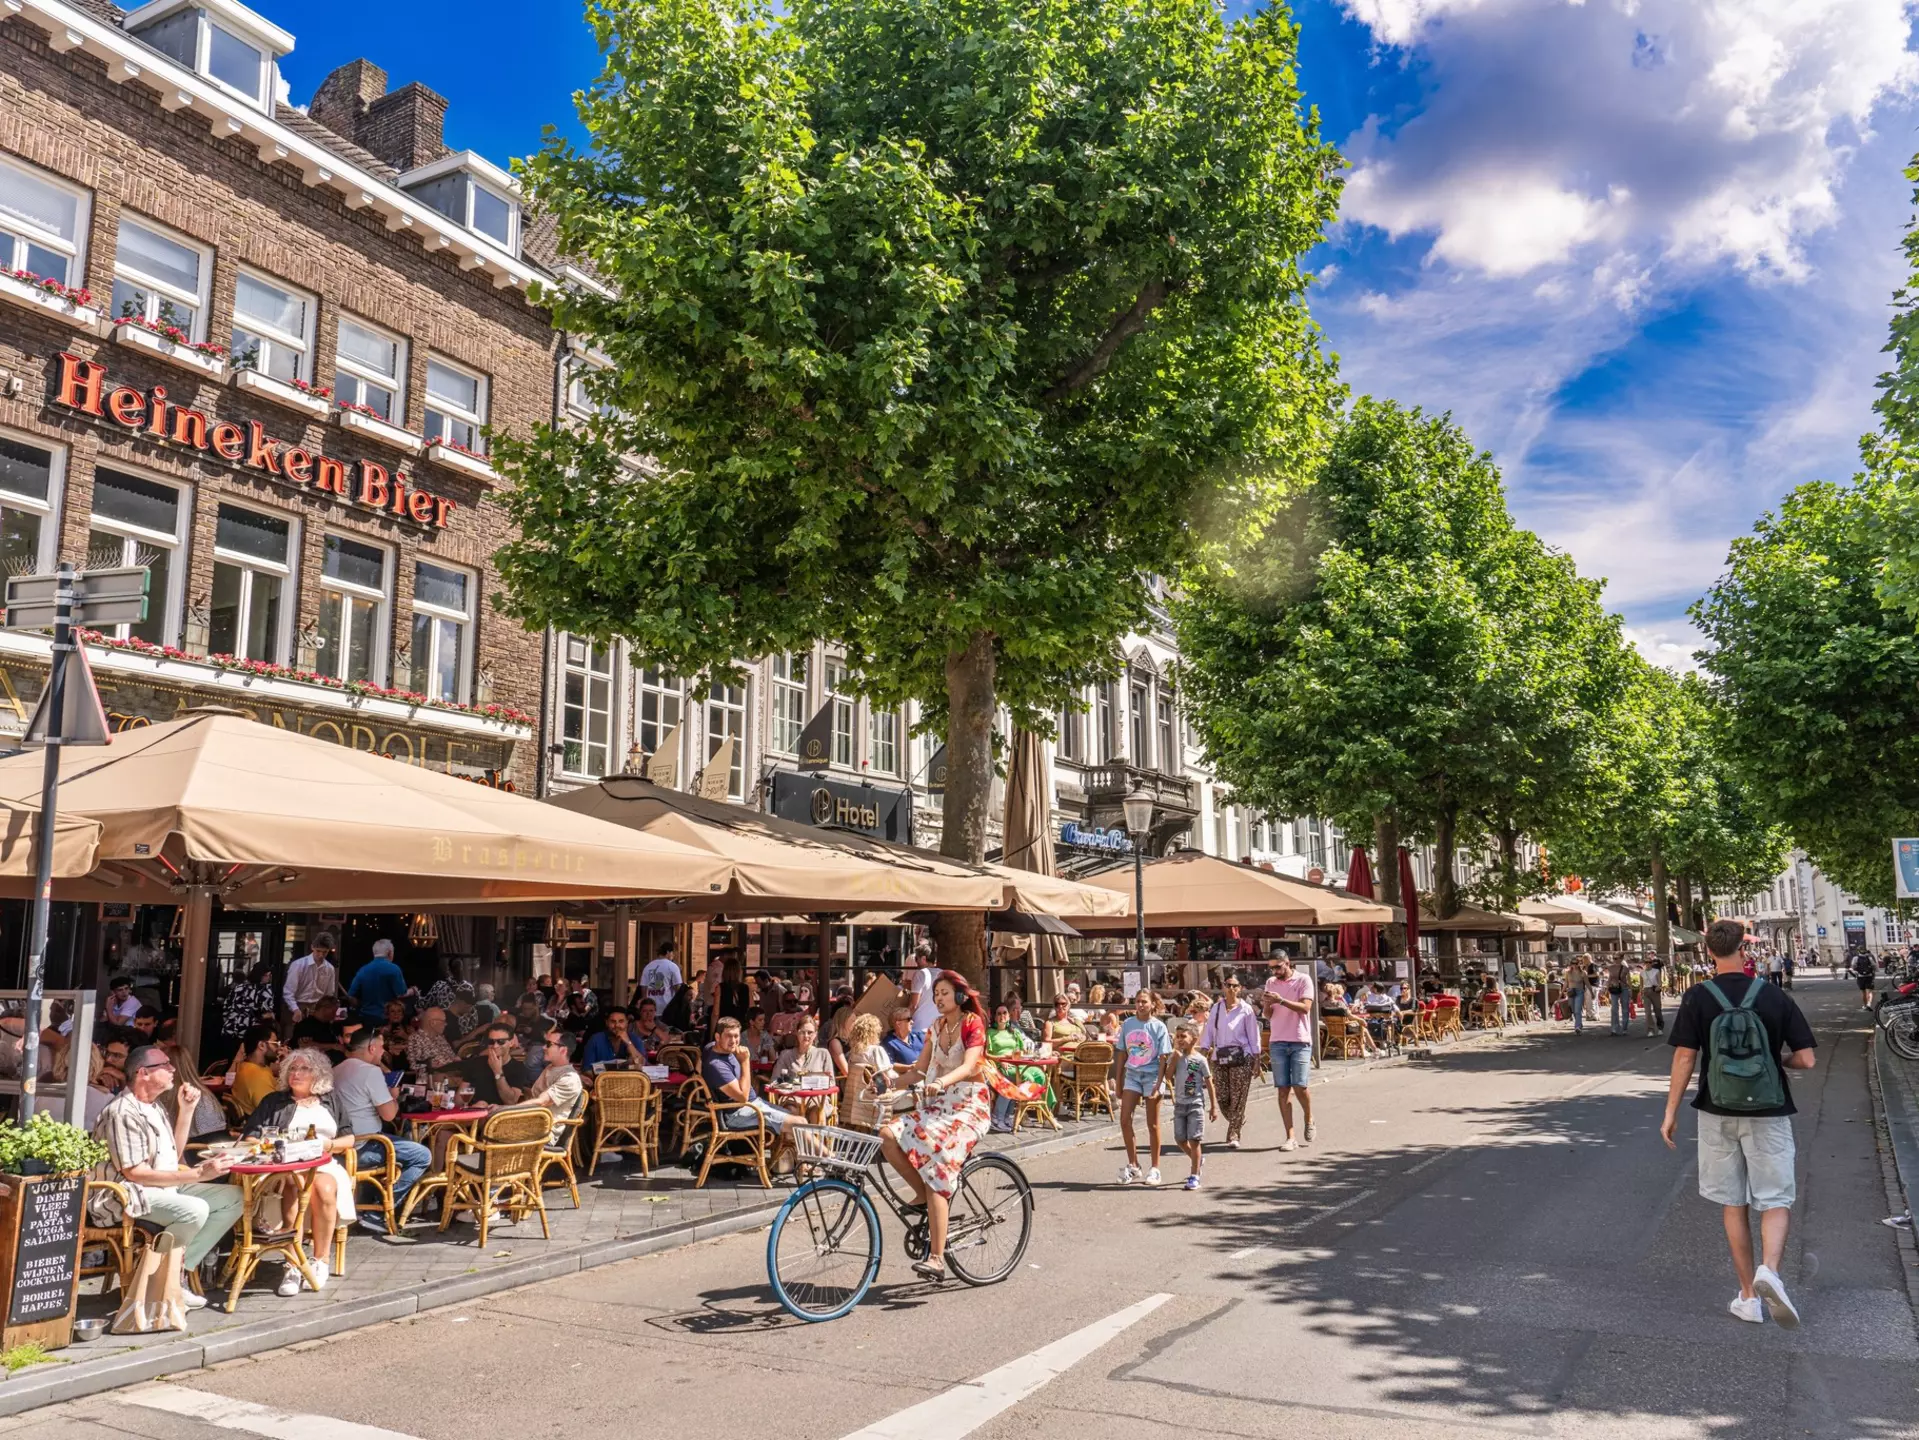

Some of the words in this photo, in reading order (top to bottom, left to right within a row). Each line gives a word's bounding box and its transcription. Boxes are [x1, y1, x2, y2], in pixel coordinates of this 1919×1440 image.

[55, 351, 345, 494] Heineken
[358, 458, 457, 529] Bier
[836, 797, 879, 828] Hotel
[432, 836, 585, 874] Brasserie
[36, 1192, 70, 1204] DINER
[34, 1201, 68, 1213] VLEES
[30, 1214, 72, 1230] PASTA'S
[42, 1210, 60, 1220] VIS
[37, 1225, 64, 1236] VEGA
[24, 1231, 73, 1247] SALADES
[26, 1254, 66, 1269] BIEREN
[22, 1264, 64, 1279] WIJNEN
[16, 1271, 73, 1288] COCKTAILS
[22, 1288, 65, 1303] BORREL
[21, 1299, 63, 1314] HAPJES
